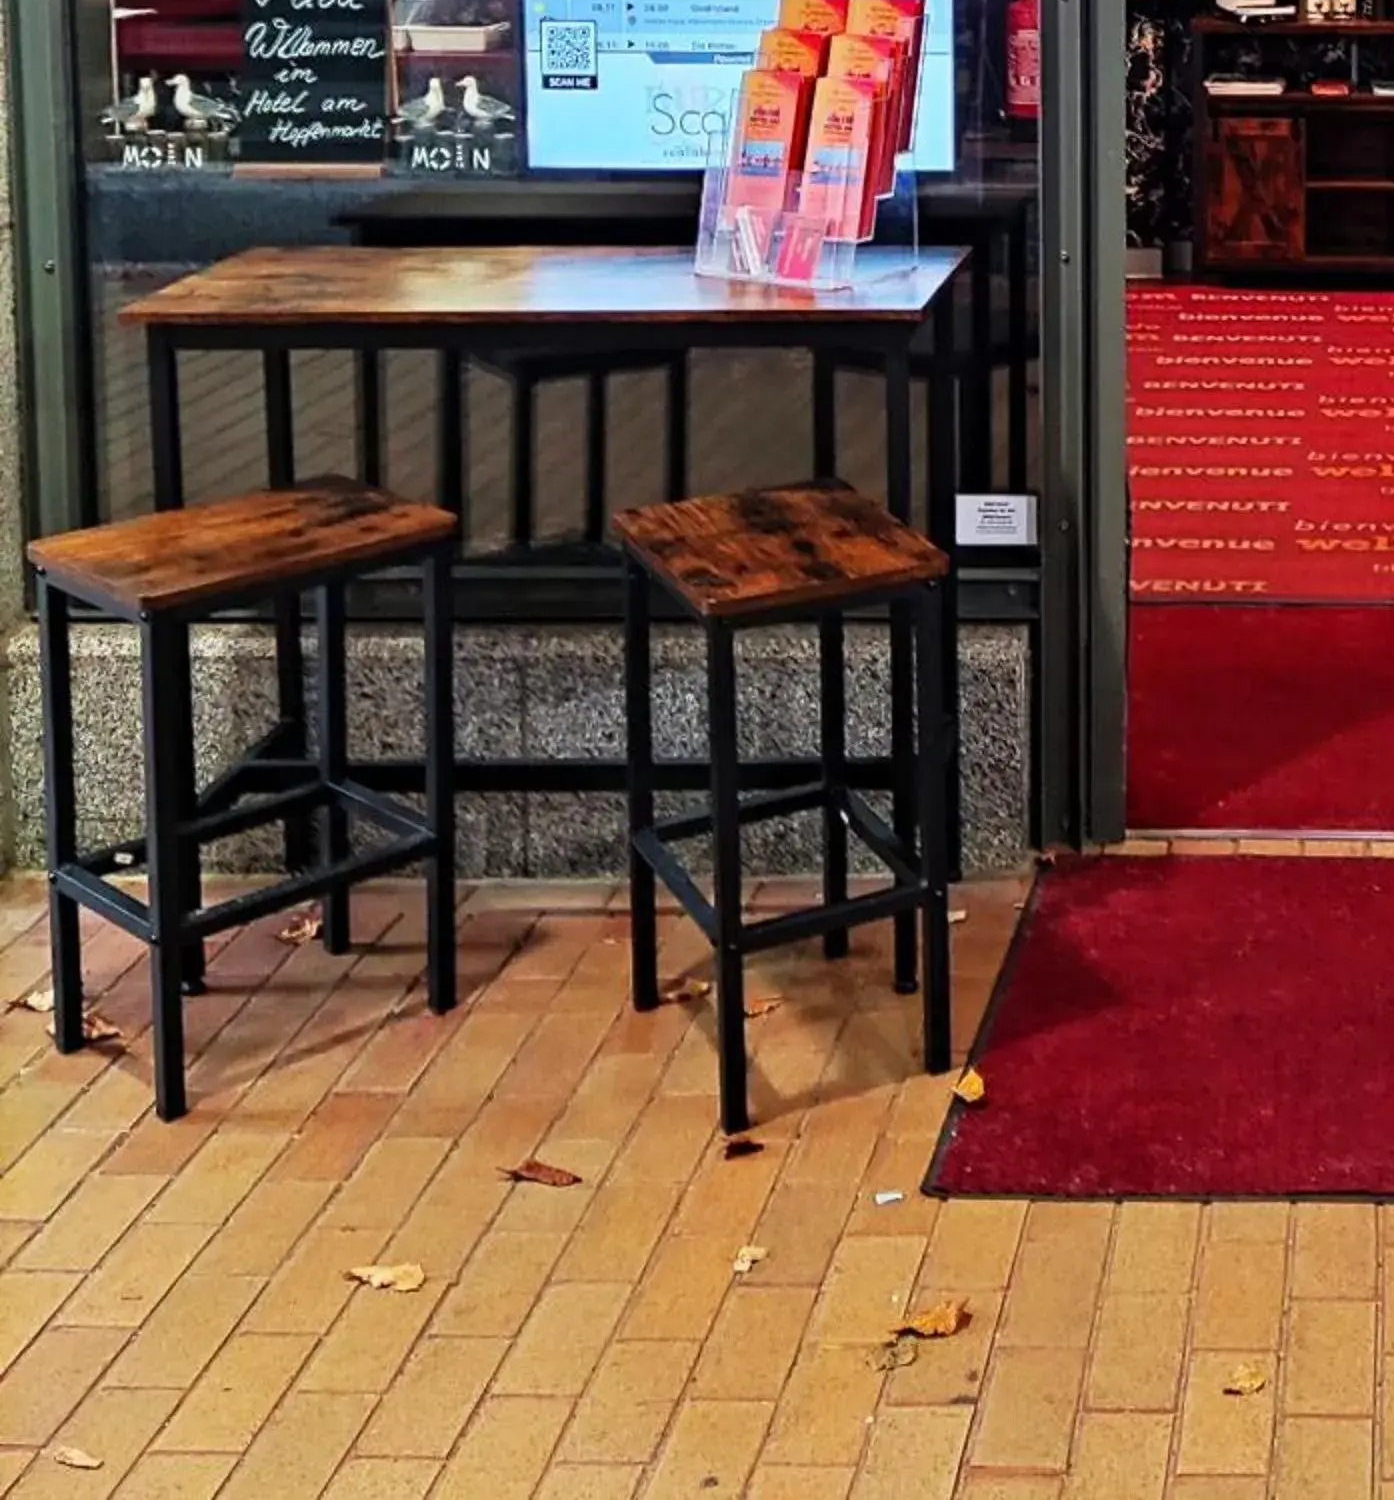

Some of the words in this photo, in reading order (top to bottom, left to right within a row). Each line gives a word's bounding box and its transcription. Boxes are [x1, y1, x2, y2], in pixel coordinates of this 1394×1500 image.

[549, 78, 574, 87] SCAN
[243, 90, 308, 117] Hotel
[321, 97, 367, 112] am
[652, 93, 727, 135] Sca
[1136, 407, 1305, 417] bienvenue
[1129, 466, 1293, 477] ienvenue
[1131, 538, 1275, 550] nvenue
[1129, 580, 1269, 592] VENUTI
